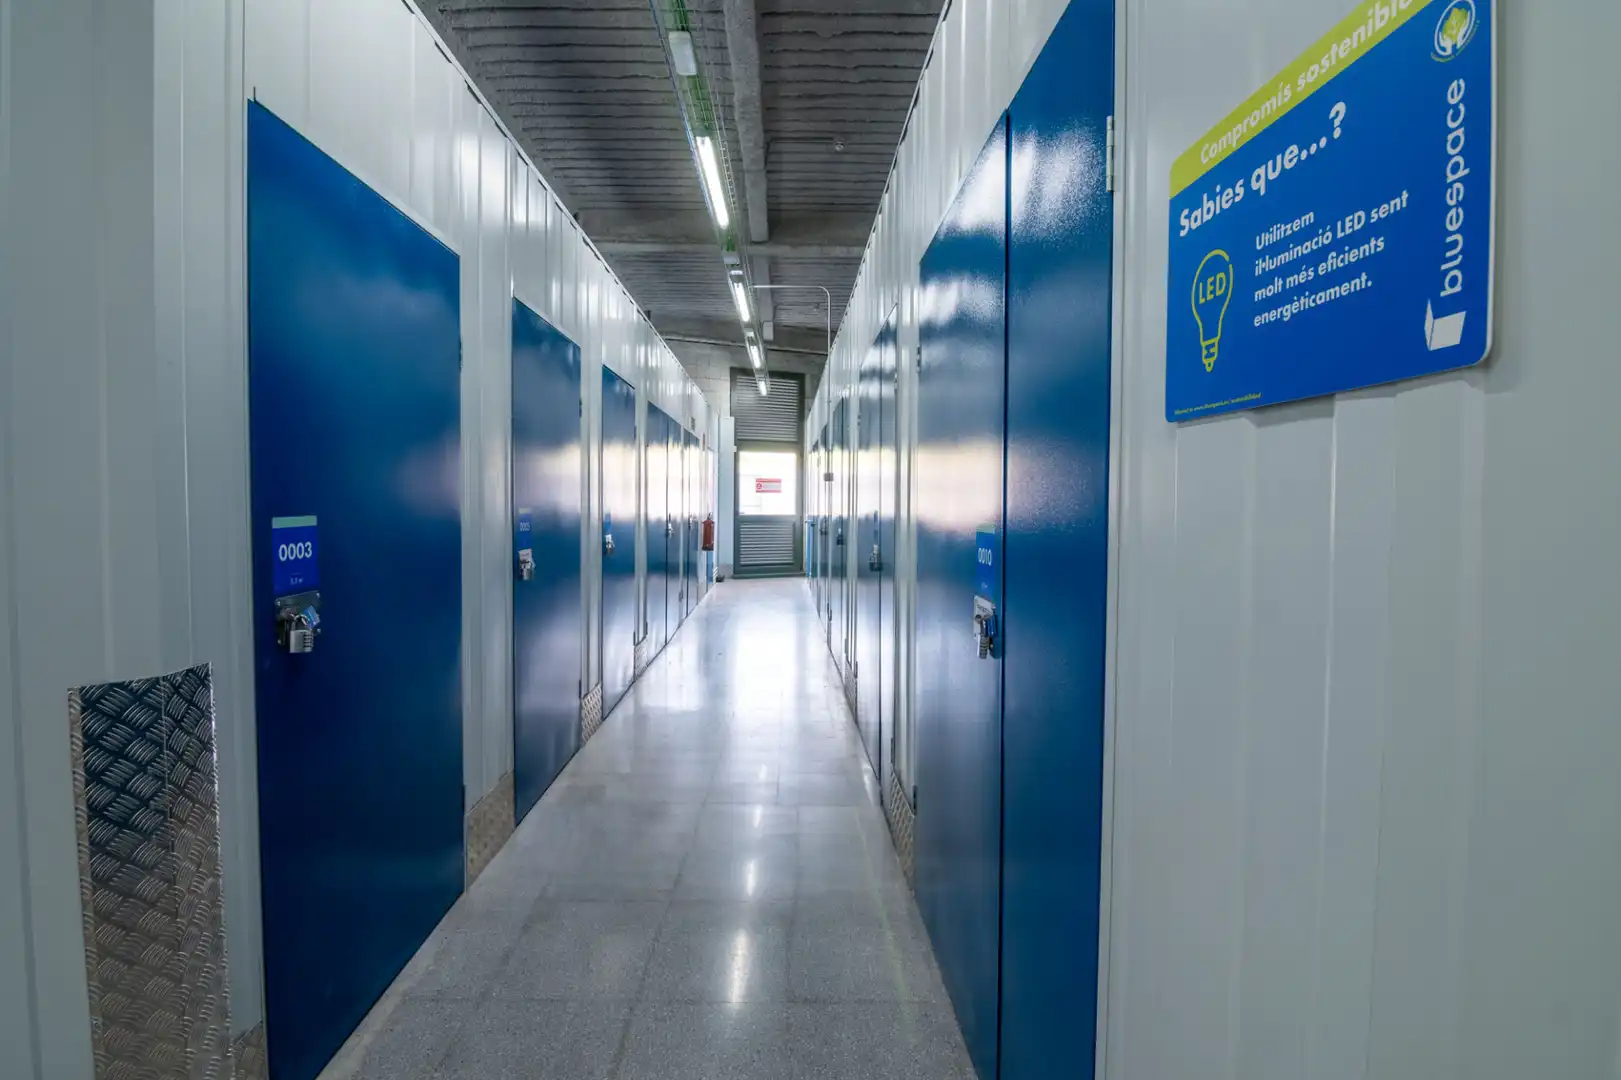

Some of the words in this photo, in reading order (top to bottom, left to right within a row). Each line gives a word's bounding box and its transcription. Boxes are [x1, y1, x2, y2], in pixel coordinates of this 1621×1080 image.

[1200, 81, 1292, 165] Compromís
[1179, 177, 1245, 237] Sabies
[1336, 209, 1366, 239] LED
[1369, 189, 1409, 224] sent
[1440, 78, 1470, 297] bluespace
[1255, 211, 1315, 251] Utilitzem
[1198, 271, 1227, 305] LED
[1254, 276, 1284, 303] molt
[1285, 265, 1315, 290] més
[1317, 236, 1386, 276] eficients
[1253, 272, 1373, 328] energèticament.
[278, 541, 312, 562] 0003
[977, 547, 993, 567] 0010
